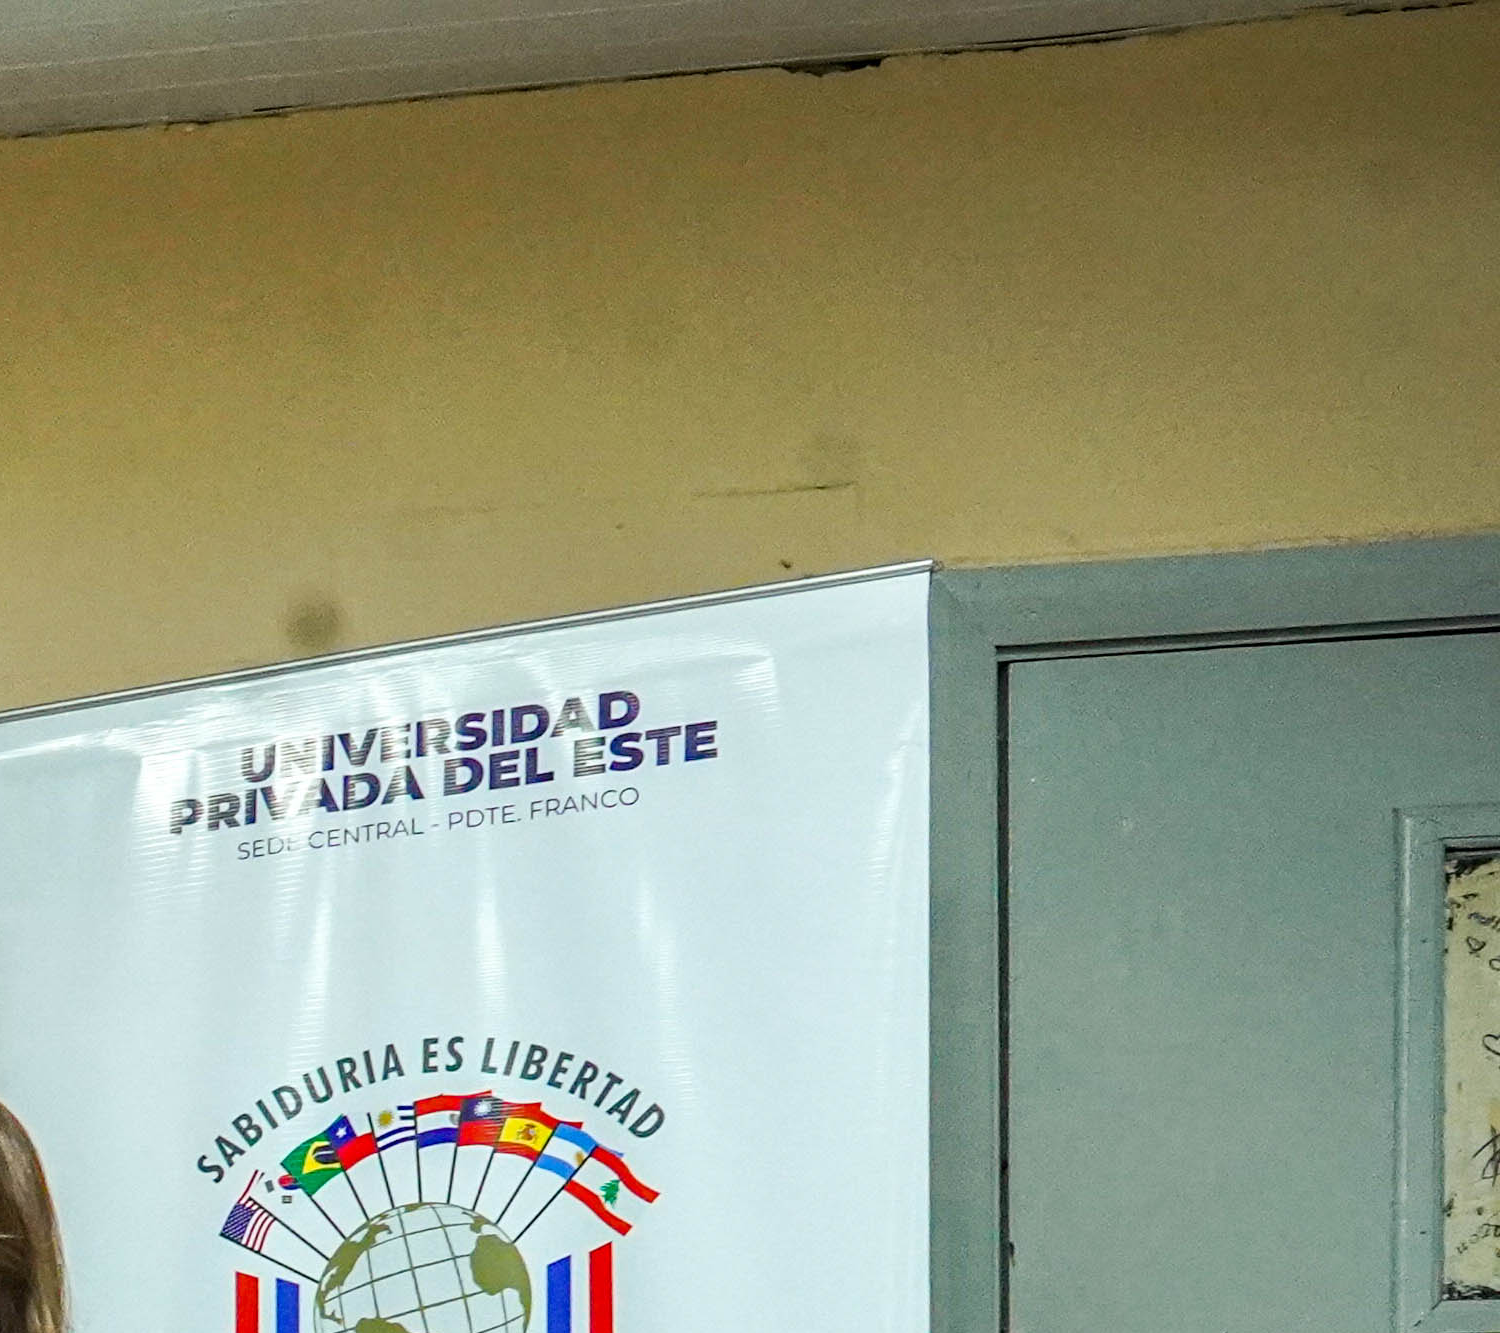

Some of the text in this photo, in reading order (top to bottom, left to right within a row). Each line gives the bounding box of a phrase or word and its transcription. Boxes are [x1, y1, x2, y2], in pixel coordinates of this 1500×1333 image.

[169, 720, 719, 835] PRIVADA DEL ESTE
[240, 690, 641, 783] UNIVERSIDAD
[308, 817, 425, 850] CENTRAL
[448, 805, 522, 830] PDTE.
[530, 787, 640, 821] FRANCO
[197, 1035, 666, 1184] SABIDURIA ES LIBERTAD
